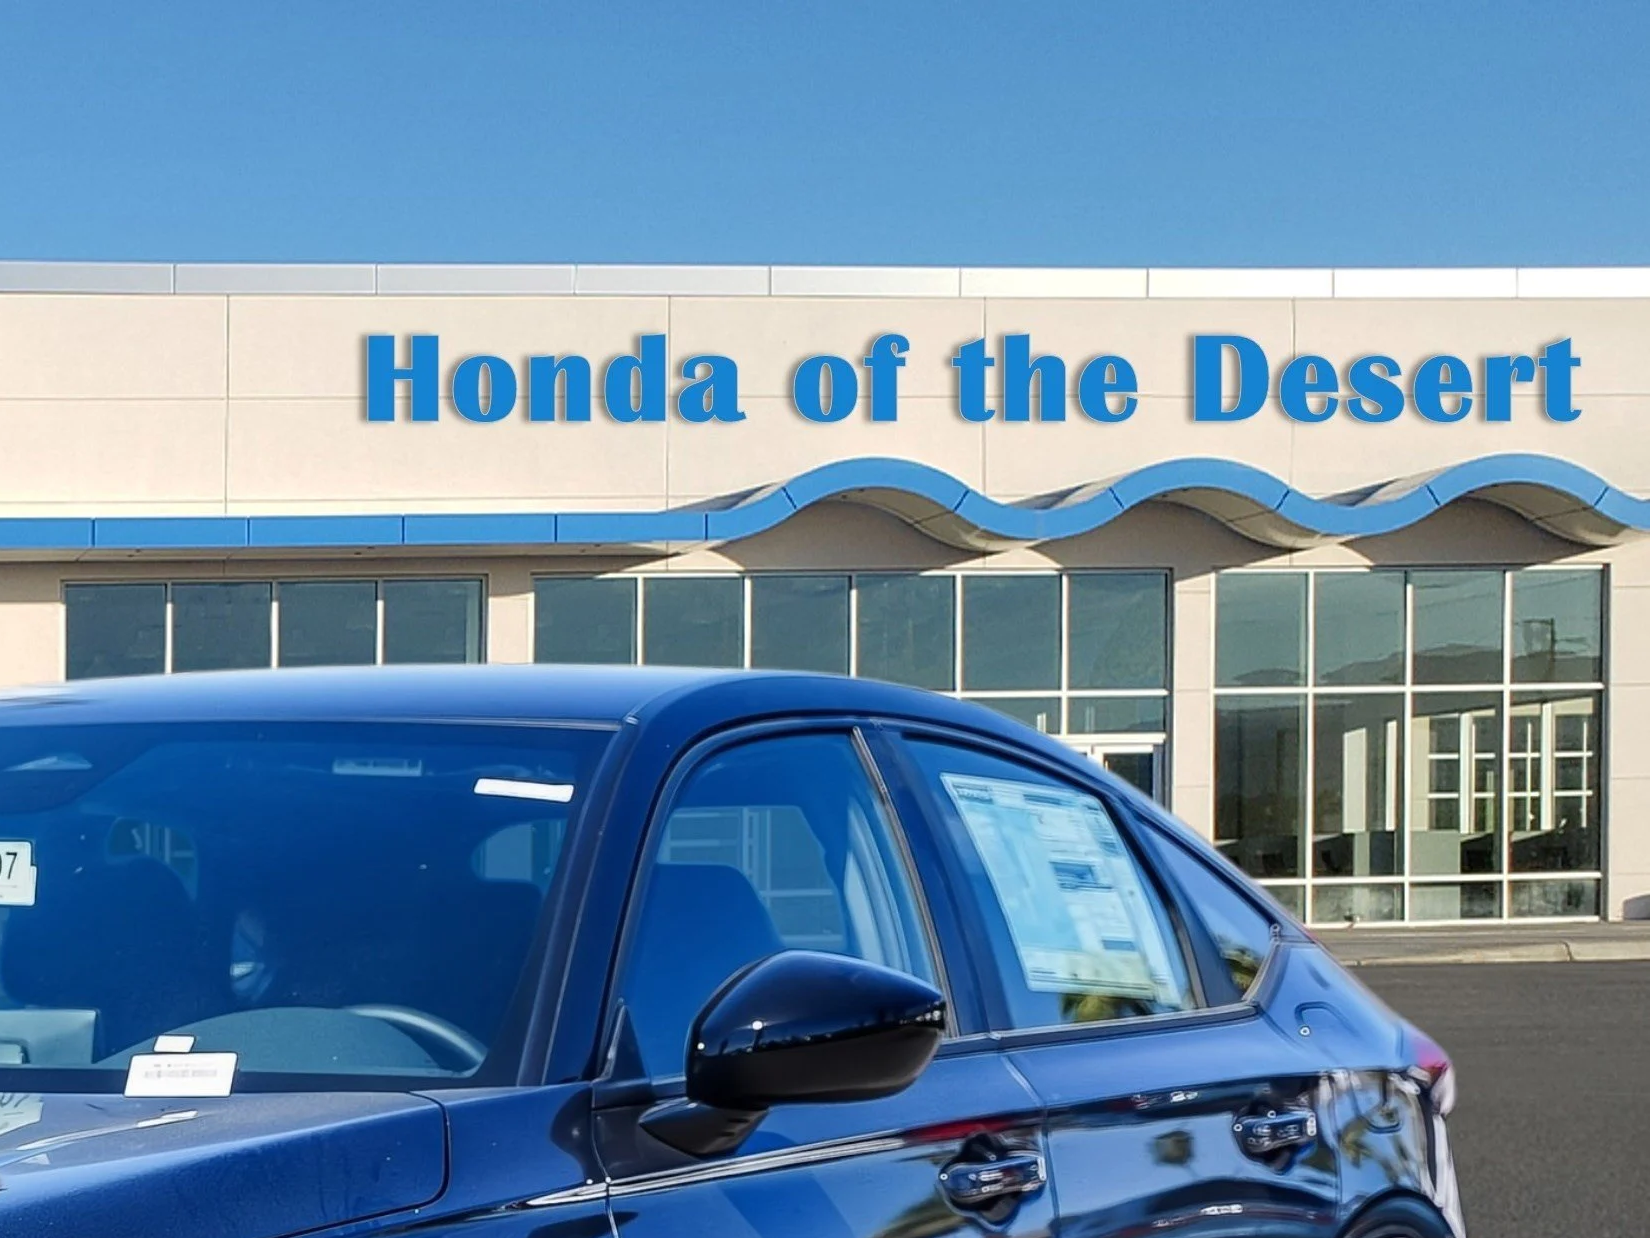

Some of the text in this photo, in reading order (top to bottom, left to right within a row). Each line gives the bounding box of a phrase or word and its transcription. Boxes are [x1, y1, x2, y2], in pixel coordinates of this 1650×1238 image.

[366, 333, 1582, 423] Honda of the Desert
